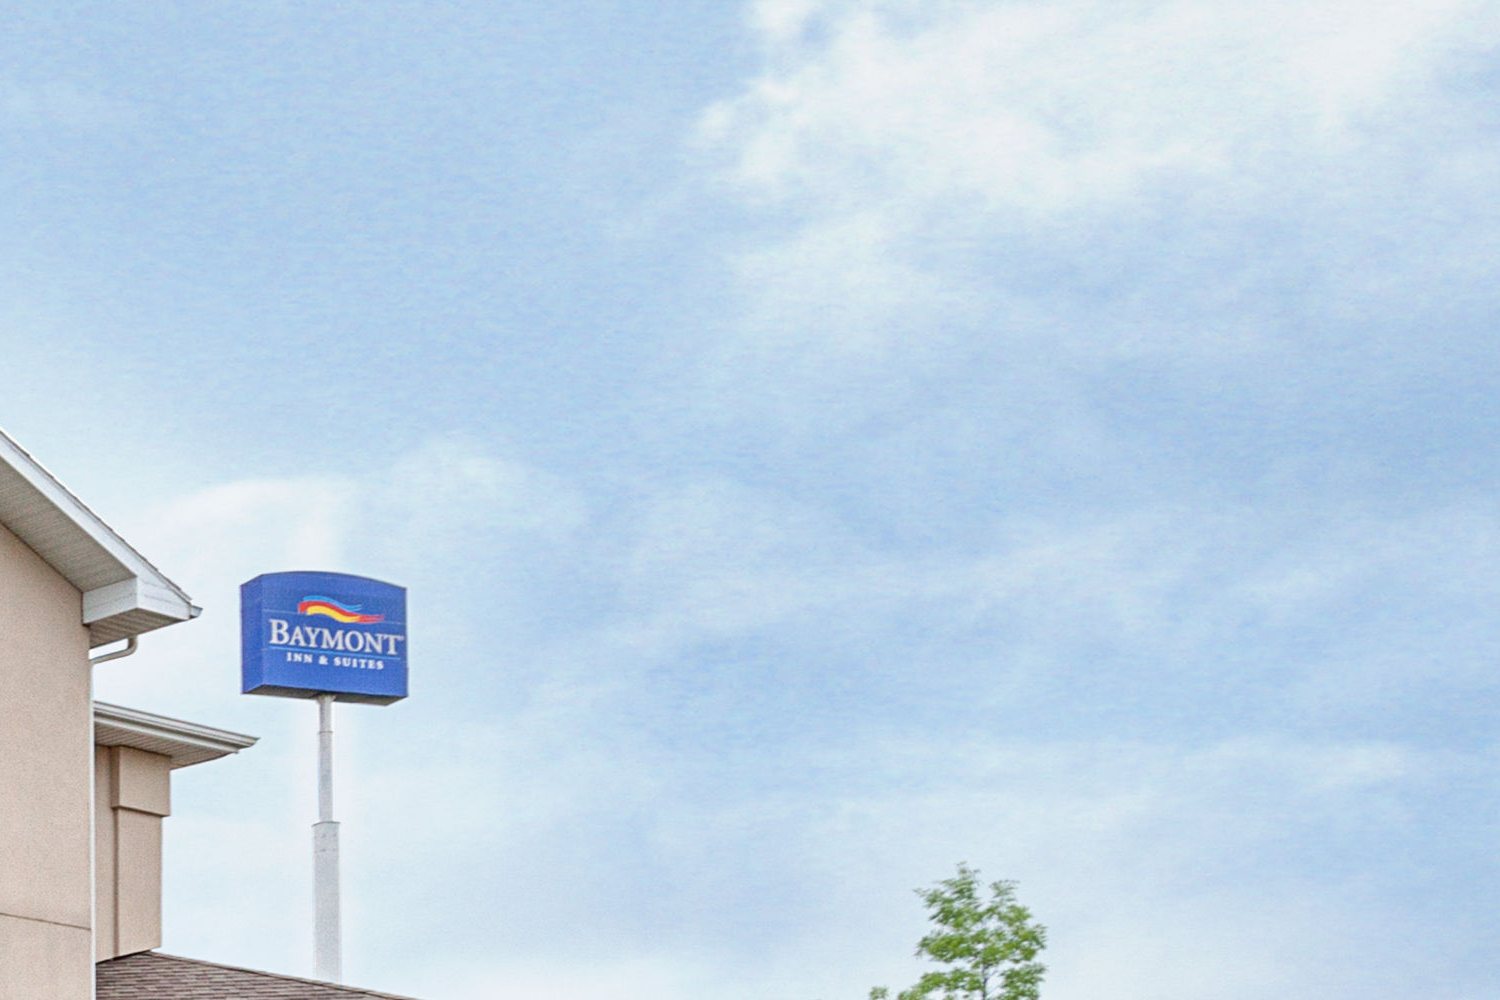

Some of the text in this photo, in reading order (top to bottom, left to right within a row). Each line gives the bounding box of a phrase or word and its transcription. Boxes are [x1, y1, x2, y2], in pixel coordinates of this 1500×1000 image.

[269, 618, 404, 655] BAYMONT
[286, 651, 384, 670] INN & SUITES
